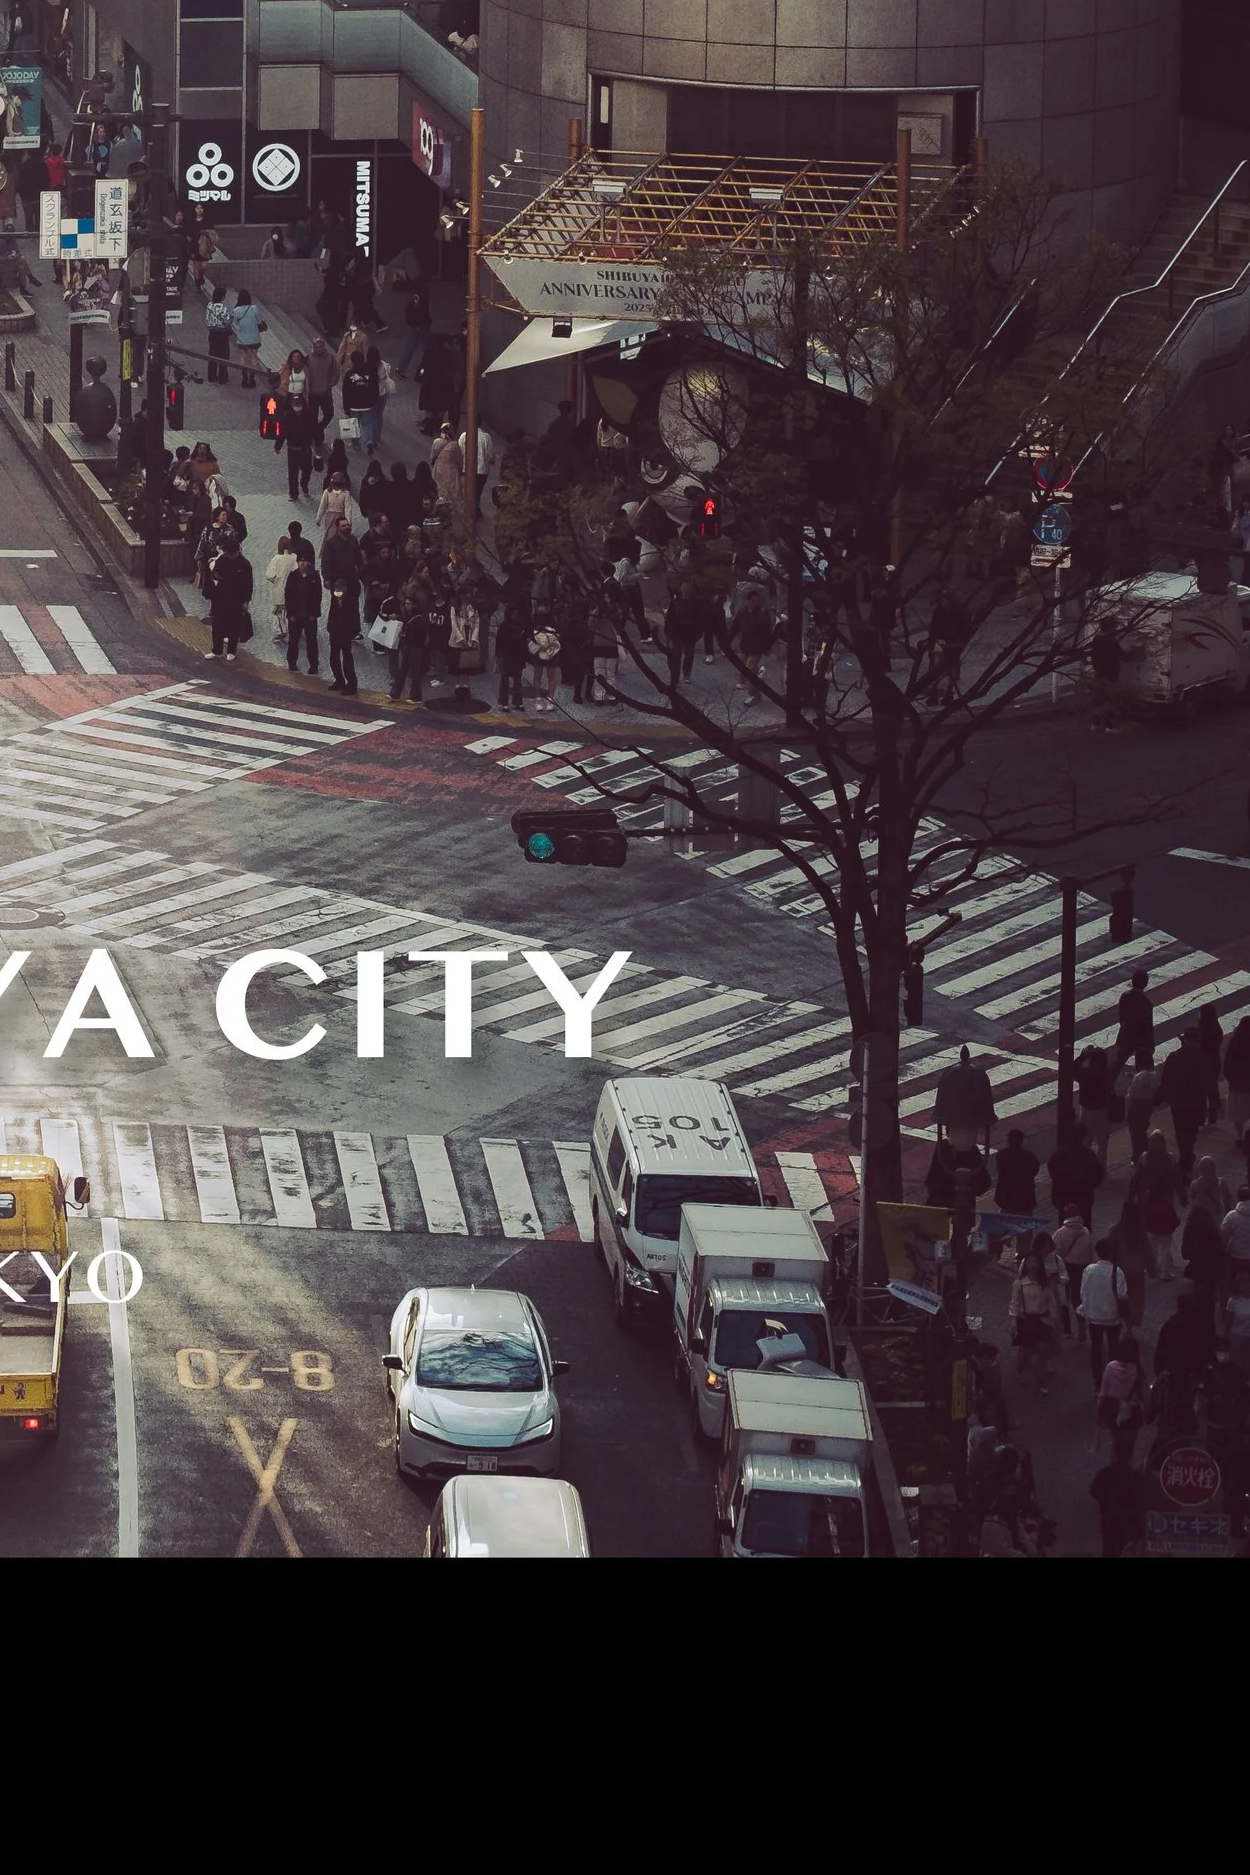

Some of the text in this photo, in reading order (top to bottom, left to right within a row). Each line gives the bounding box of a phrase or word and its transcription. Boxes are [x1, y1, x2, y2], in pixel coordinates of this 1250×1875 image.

[187, 189, 232, 202] ミツマル
[44, 194, 57, 256] スクランブル式
[108, 186, 124, 252] 道玄坂下
[596, 270, 674, 284] SHIBUYA10
[539, 282, 660, 301] ANNIVERSARY
[1165, 1463, 1215, 1489] 消火栓
